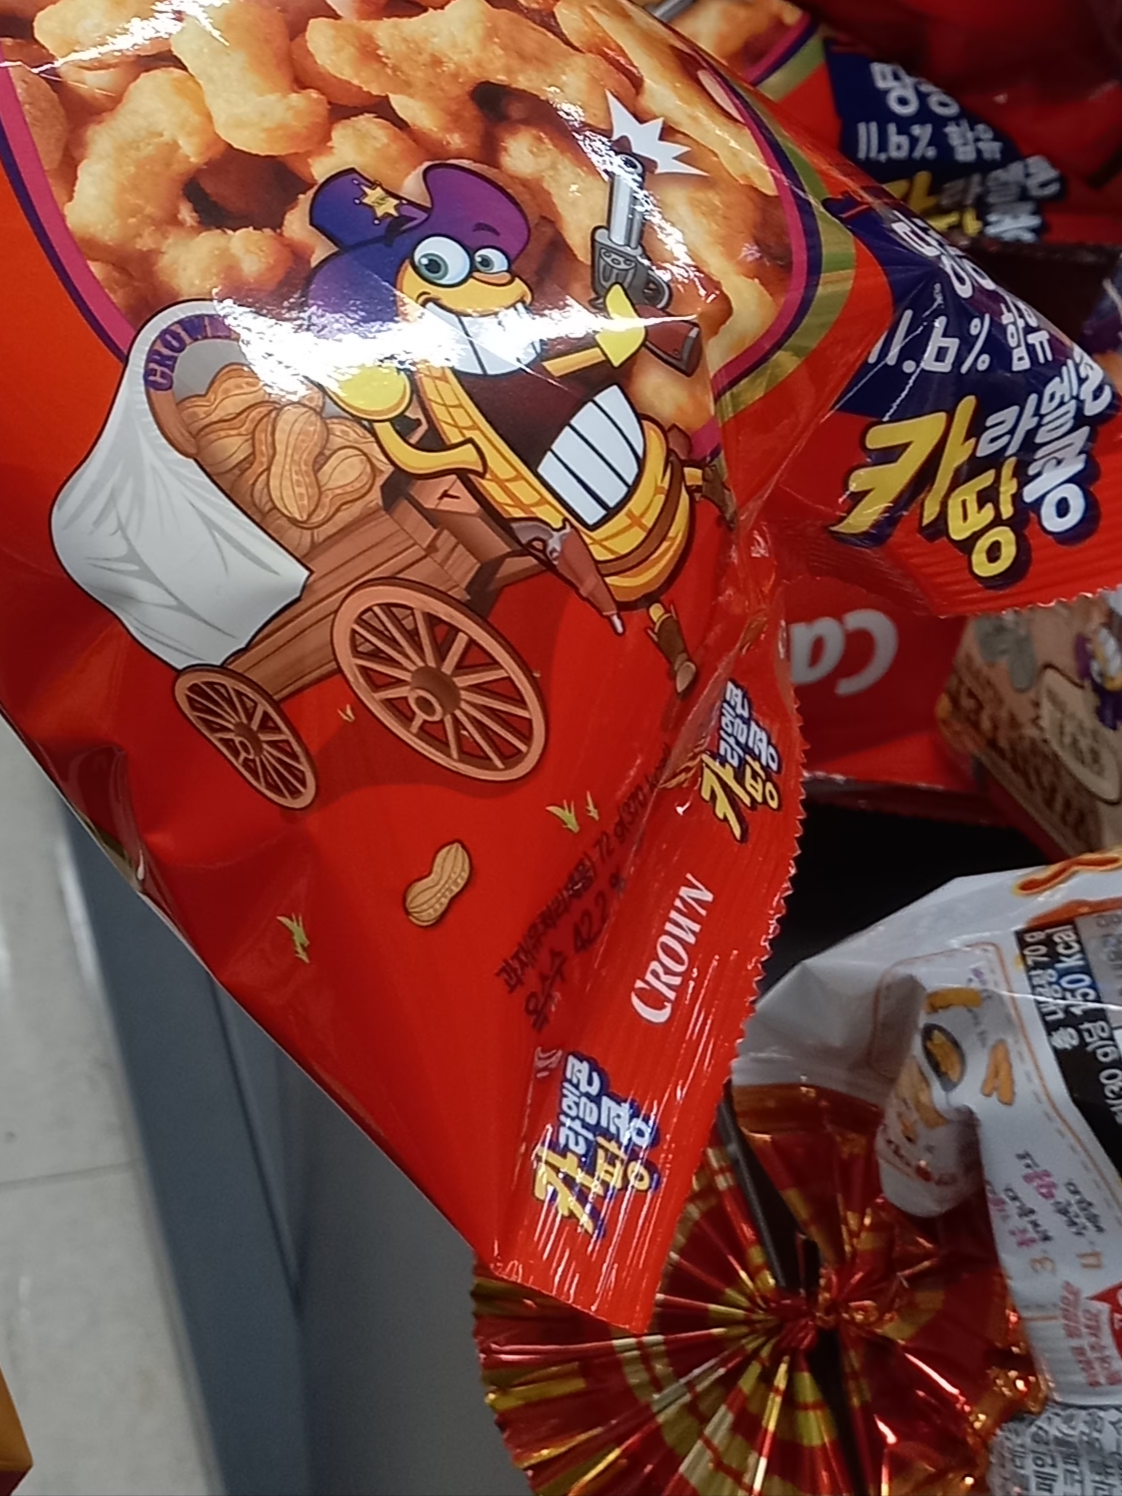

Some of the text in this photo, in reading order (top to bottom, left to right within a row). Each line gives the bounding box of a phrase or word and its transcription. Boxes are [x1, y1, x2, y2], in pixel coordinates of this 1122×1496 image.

[857, 121, 938, 164] 11.6%
[867, 309, 991, 374] 11.6%
[946, 424, 1093, 578] 땅콩
[630, 872, 715, 1025] CROWN
[1048, 924, 1085, 970] kcal
